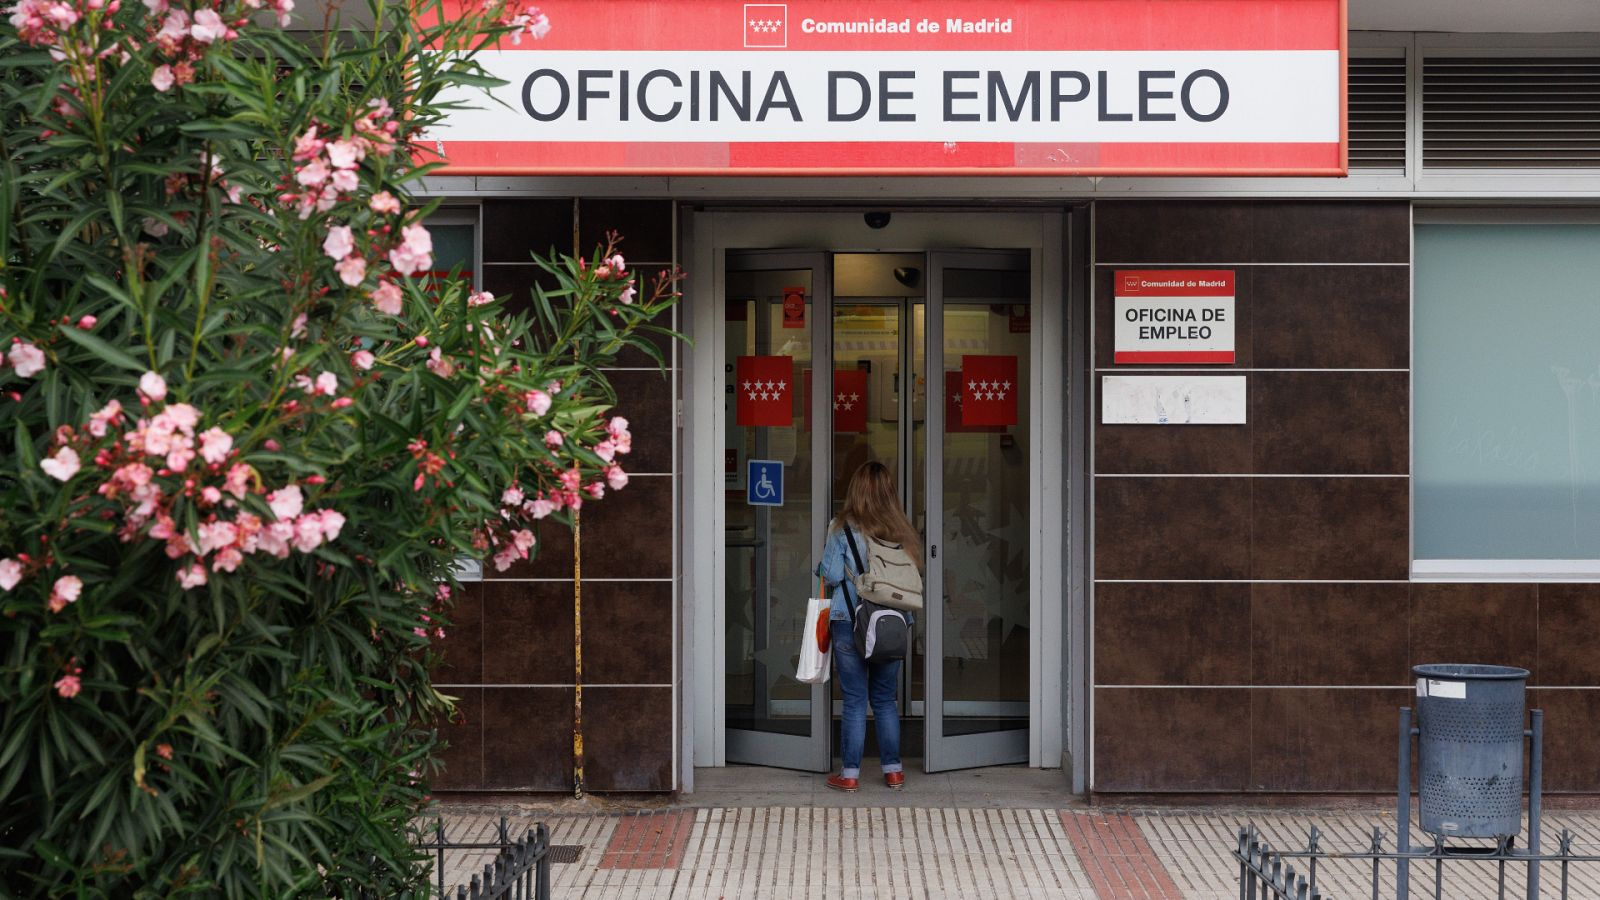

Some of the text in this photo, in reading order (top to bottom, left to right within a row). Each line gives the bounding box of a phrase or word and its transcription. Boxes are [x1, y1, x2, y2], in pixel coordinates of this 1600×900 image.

[801, 18, 1013, 34] Comunidad de Madrid
[521, 68, 1230, 123] OFICINA DE EMPLEO
[1141, 280, 1226, 288] Comunidad de Madrid
[1125, 308, 1225, 322] OFICINA DE
[1138, 325, 1212, 340] EMPLEO
